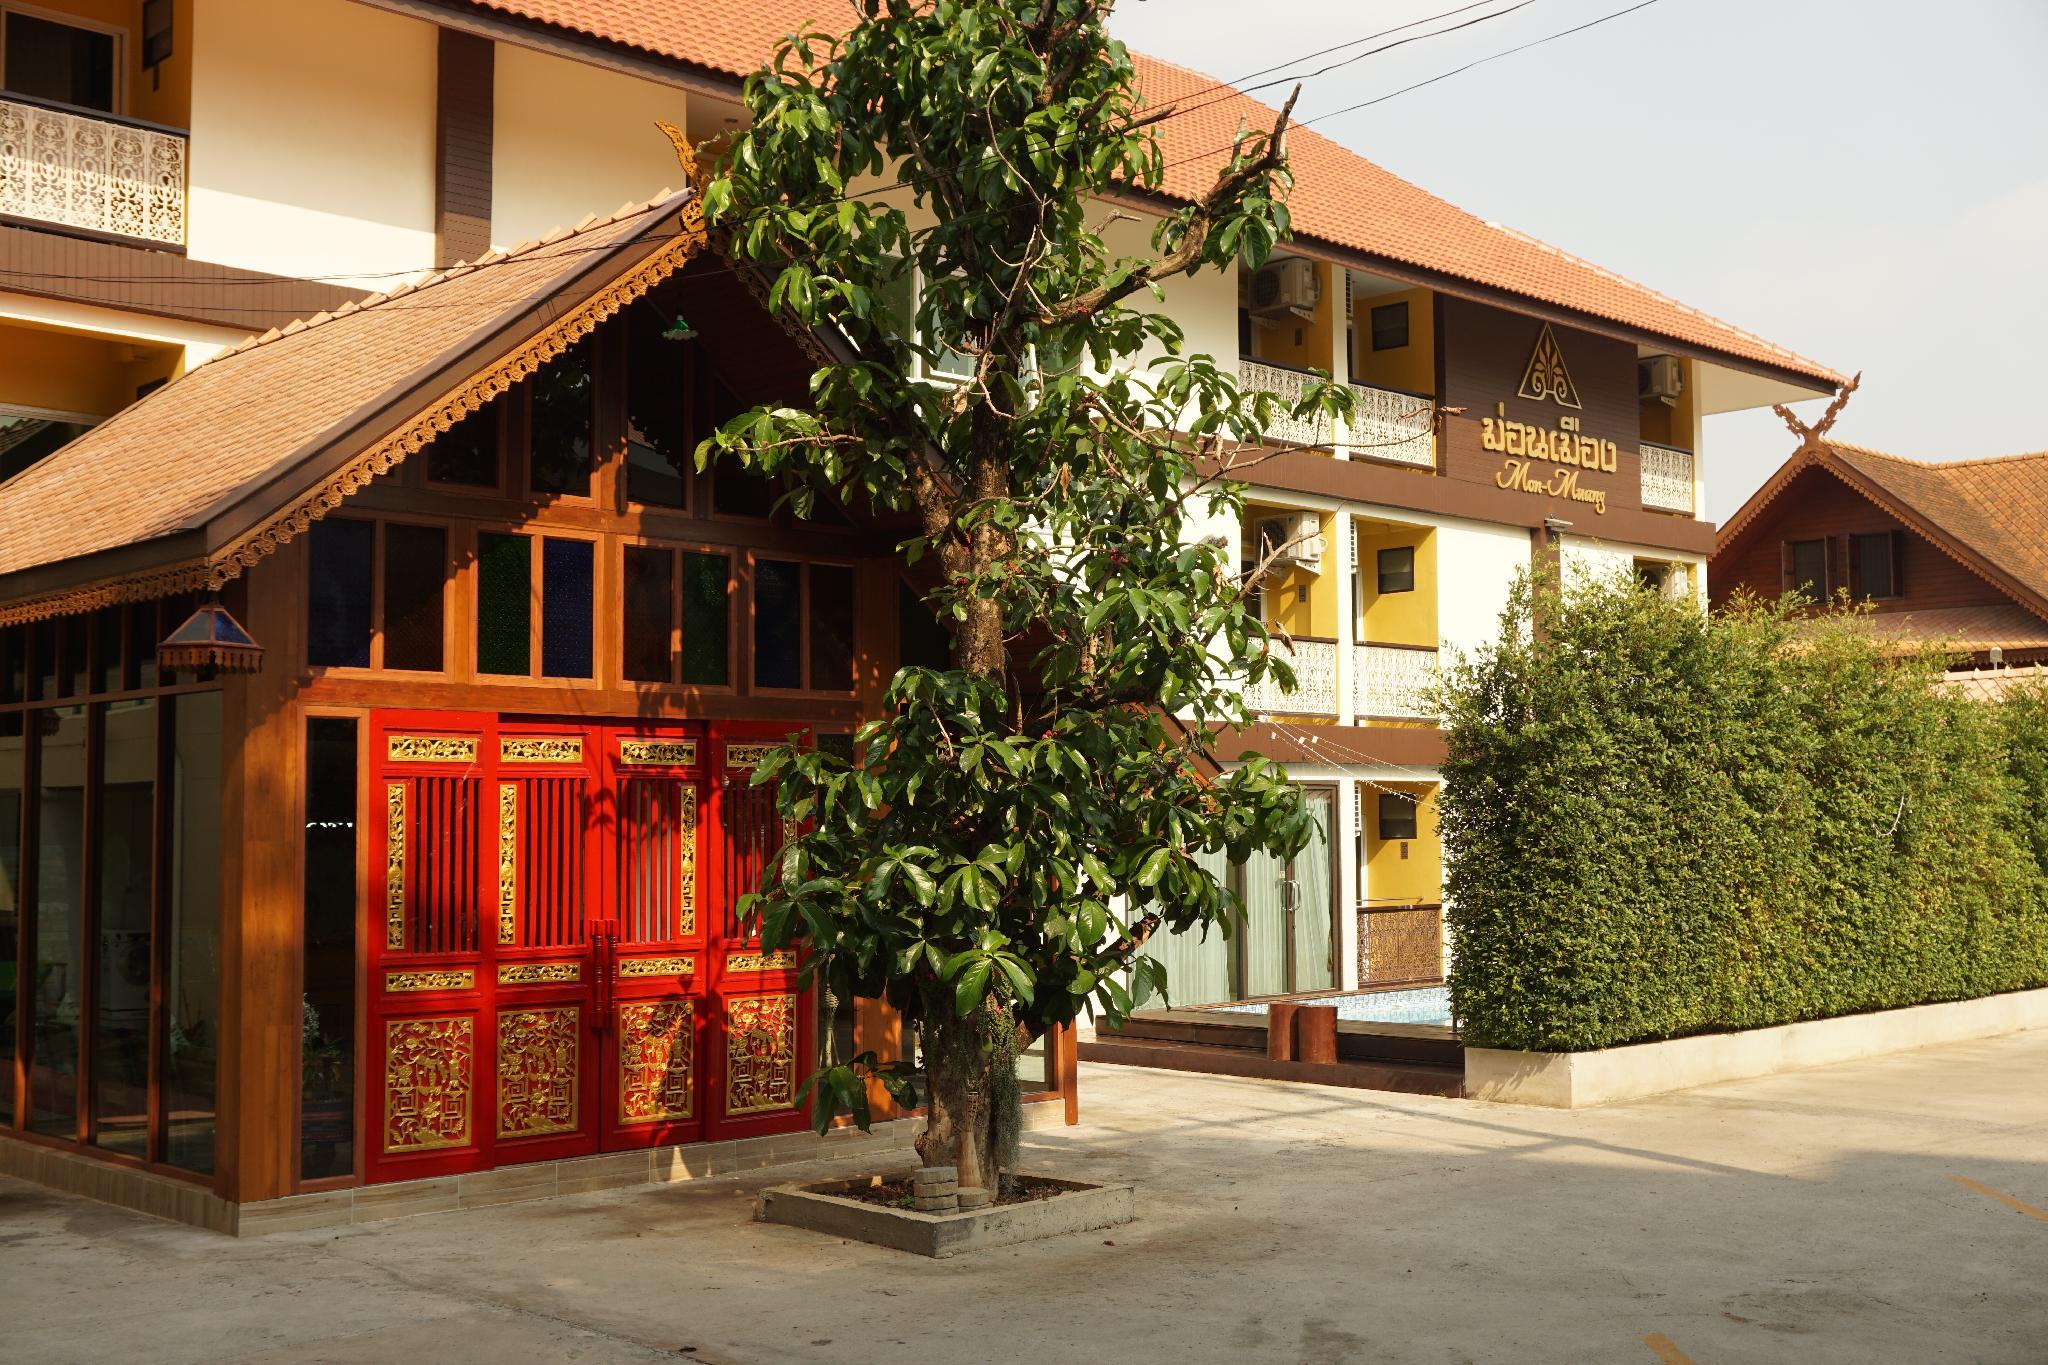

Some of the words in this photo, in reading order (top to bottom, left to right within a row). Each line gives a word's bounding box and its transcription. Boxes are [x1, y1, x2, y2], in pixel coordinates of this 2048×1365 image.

[1481, 401, 1617, 473] ม่อนเมือง
[1495, 459, 1606, 515] Mon-Muang
